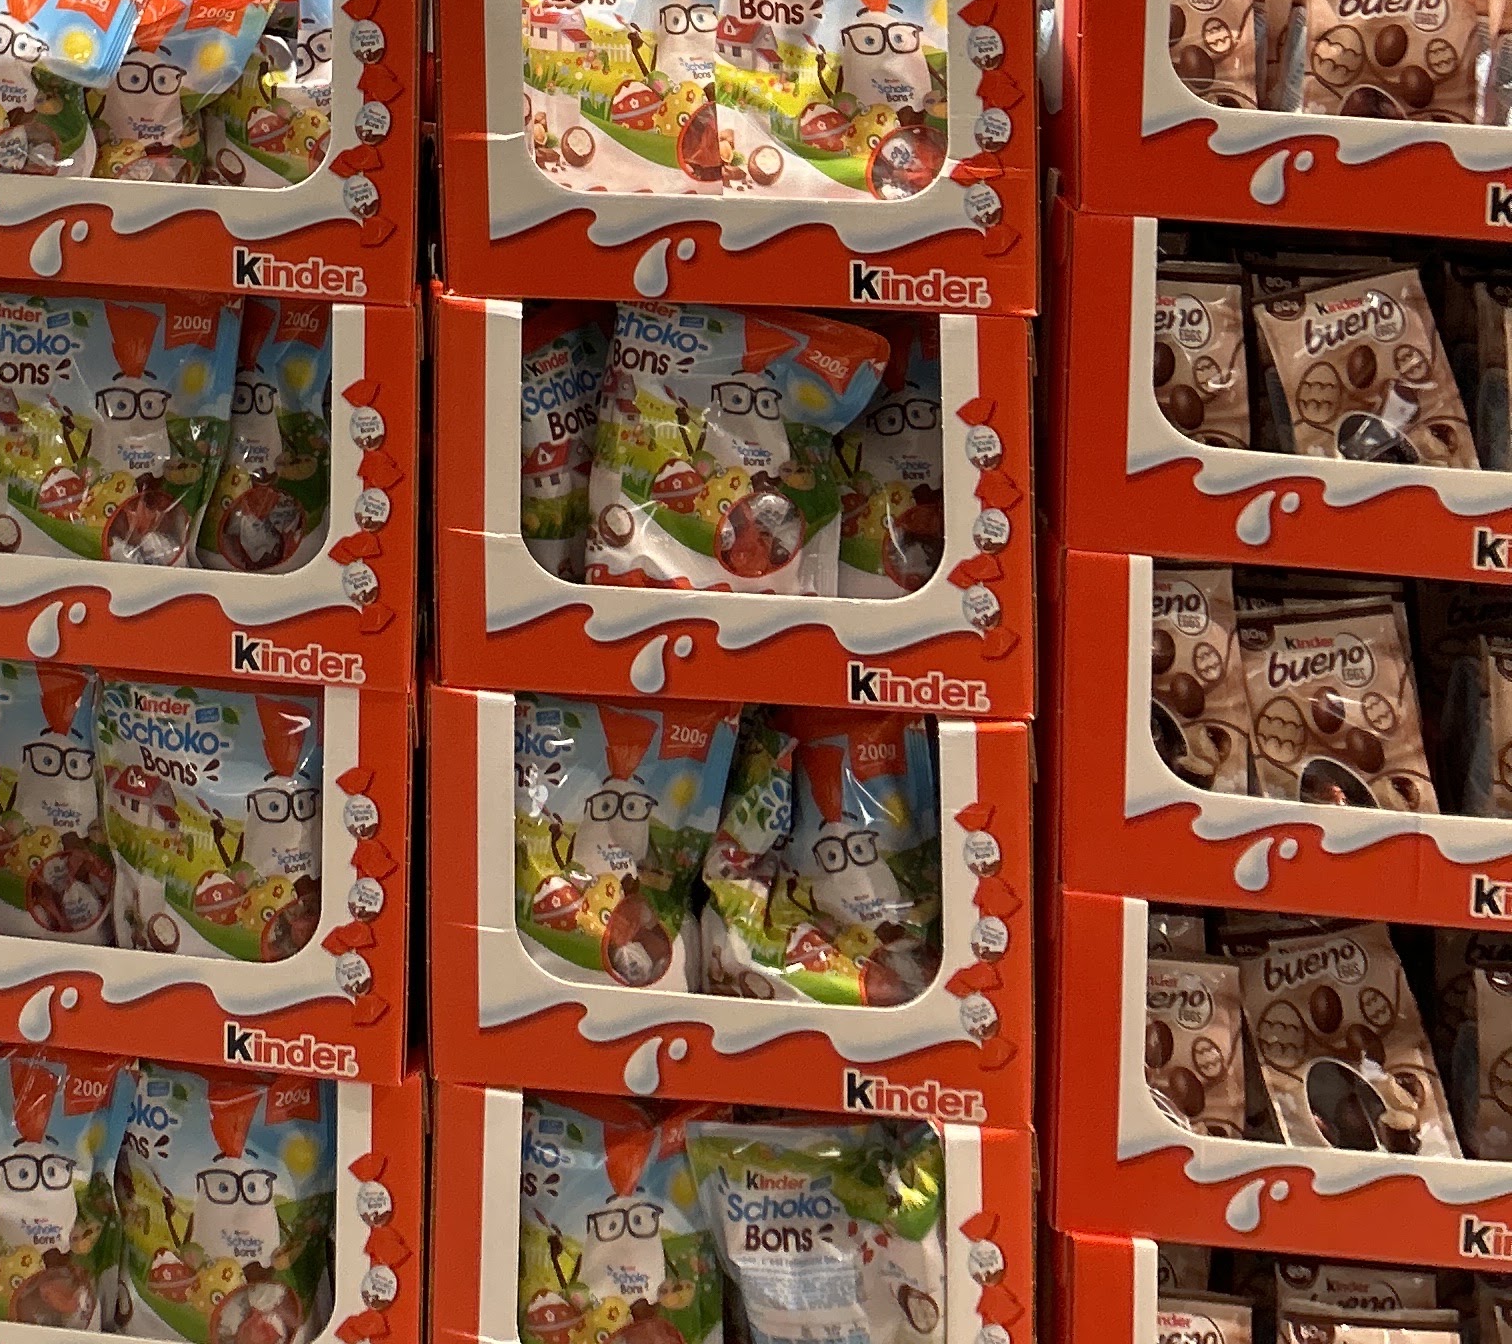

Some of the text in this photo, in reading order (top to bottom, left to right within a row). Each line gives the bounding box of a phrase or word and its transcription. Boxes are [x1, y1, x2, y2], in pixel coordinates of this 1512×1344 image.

[197, 6, 236, 21] 200g
[172, 315, 211, 333] 200g
[284, 311, 319, 331] 200g
[1305, 301, 1393, 355] bueno
[613, 338, 669, 375] Bons
[809, 350, 849, 378] 200g
[1268, 646, 1365, 688] bueno
[120, 714, 230, 755] Schoko-
[670, 725, 708, 746] 200g
[140, 746, 199, 786] Bons
[857, 743, 897, 763] 200g
[1263, 942, 1356, 992] bueno
[275, 1089, 310, 1107] 200g
[745, 1224, 813, 1253] Bons
